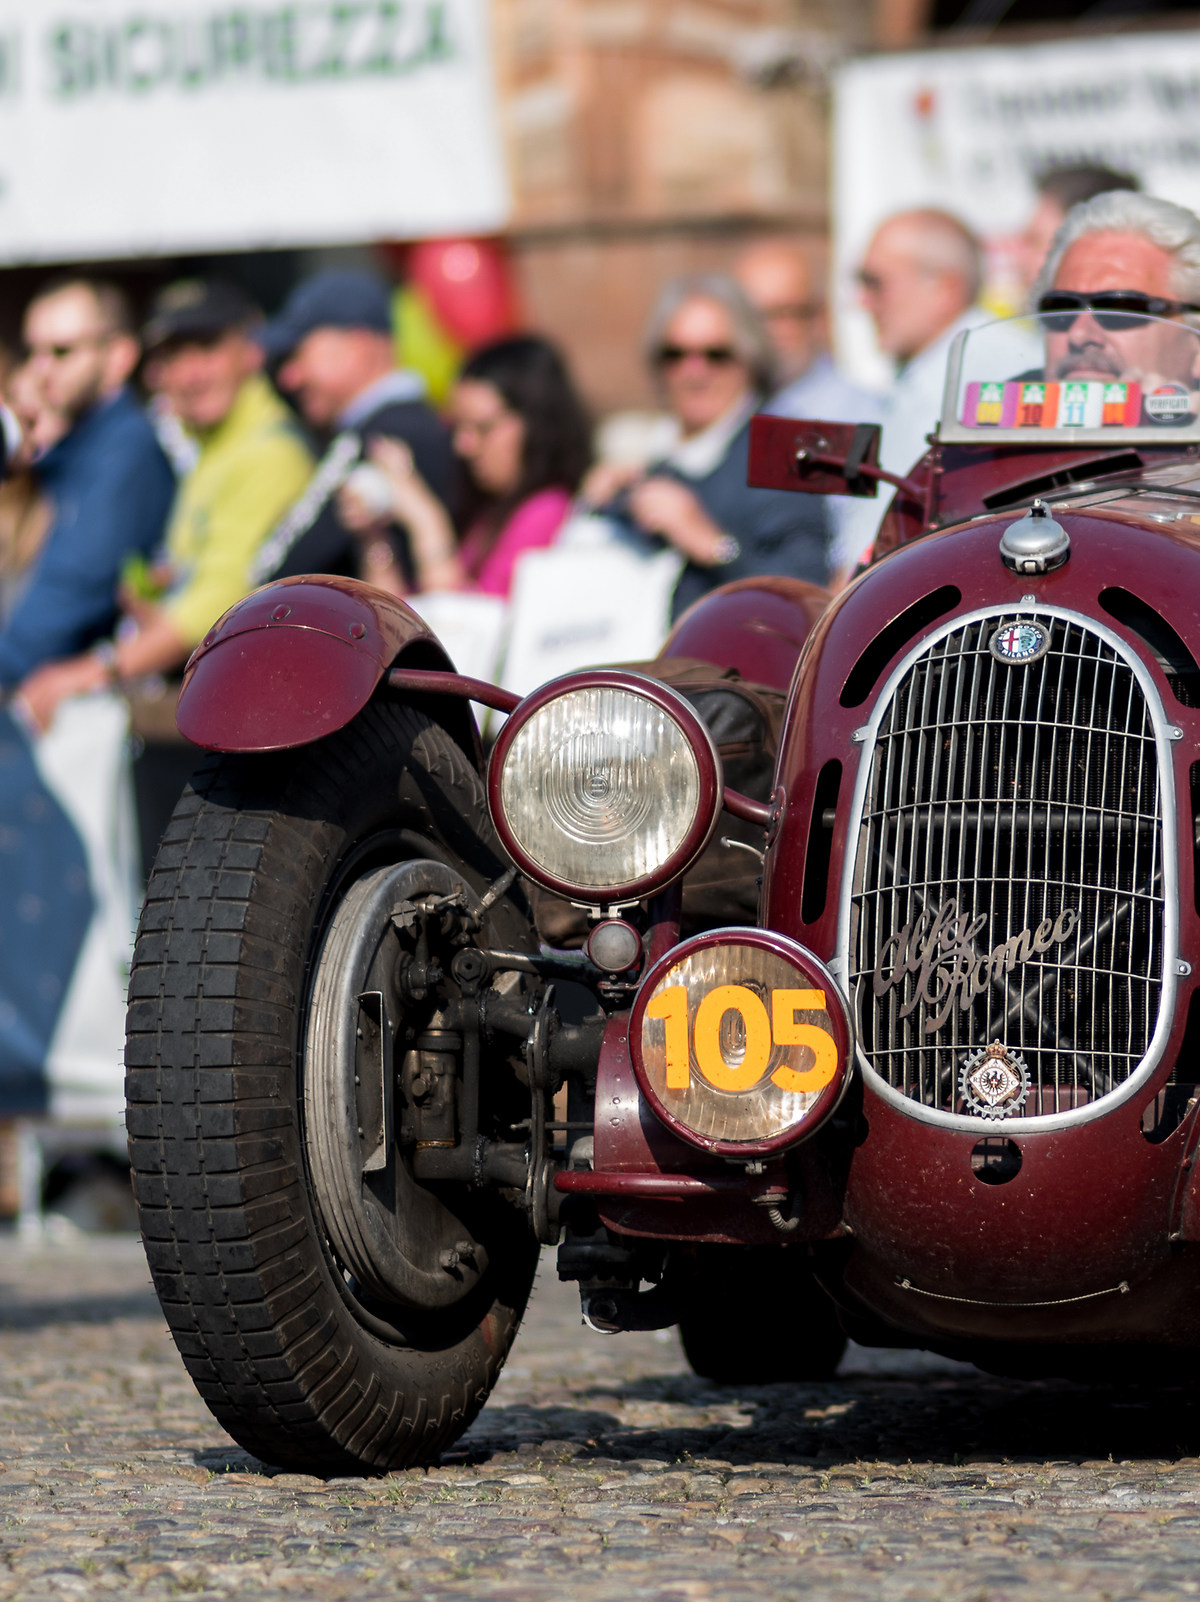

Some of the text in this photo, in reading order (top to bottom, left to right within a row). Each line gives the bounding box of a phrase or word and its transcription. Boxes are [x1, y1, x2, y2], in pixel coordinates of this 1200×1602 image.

[48, 2, 456, 99] SICUREZZA
[1021, 403, 1043, 423] 10
[1064, 403, 1086, 423] 11
[1149, 397, 1189, 410] VERIFICATO
[1001, 647, 1035, 658] MILANO
[646, 984, 839, 1094] 105
